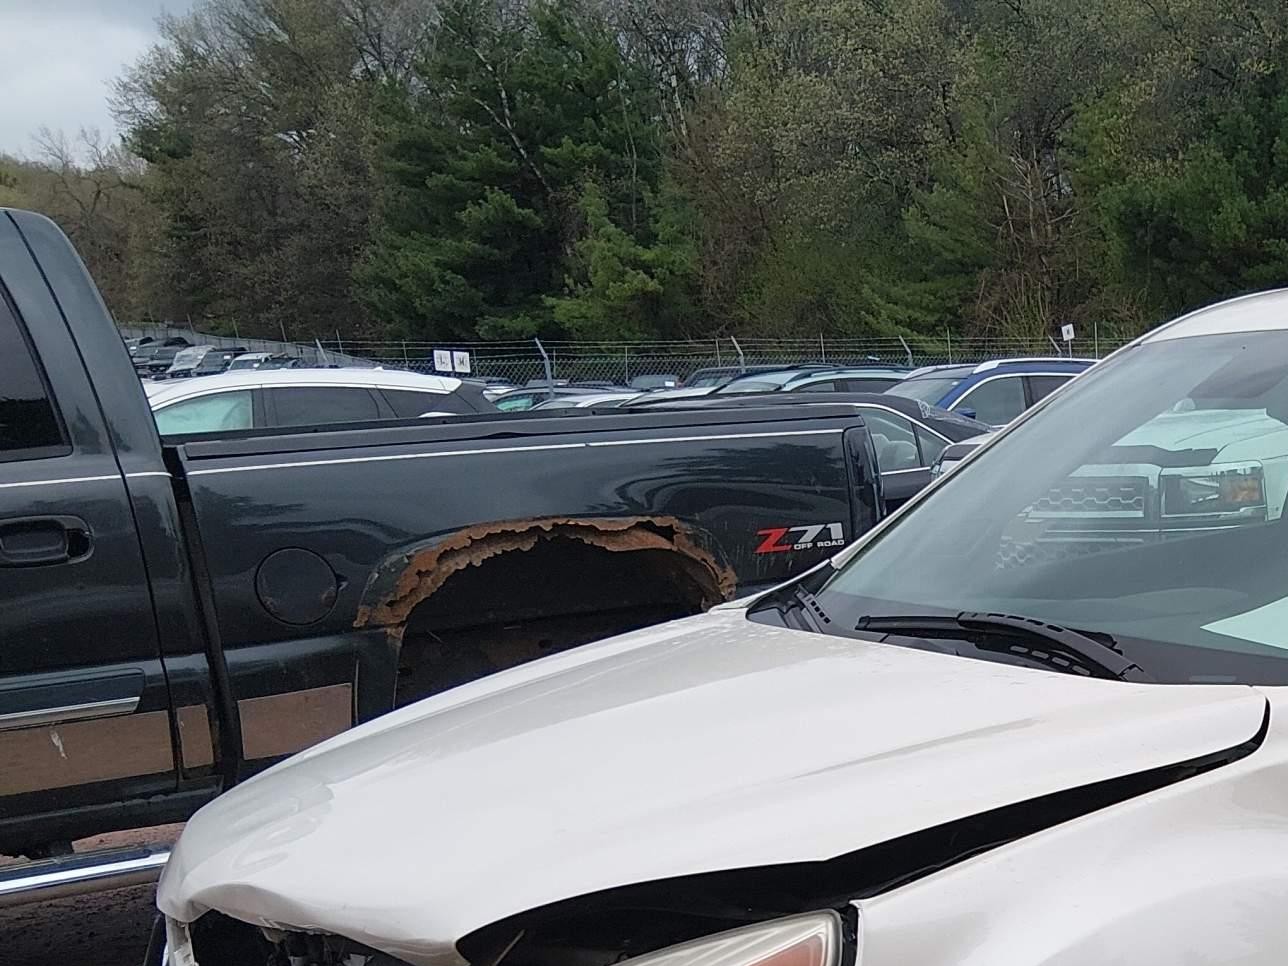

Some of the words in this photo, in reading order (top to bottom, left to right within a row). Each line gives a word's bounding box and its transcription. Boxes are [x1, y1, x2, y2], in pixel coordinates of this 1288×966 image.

[754, 522, 844, 553] Z71
[793, 542, 814, 551] OFF
[816, 539, 845, 548] ROAD
